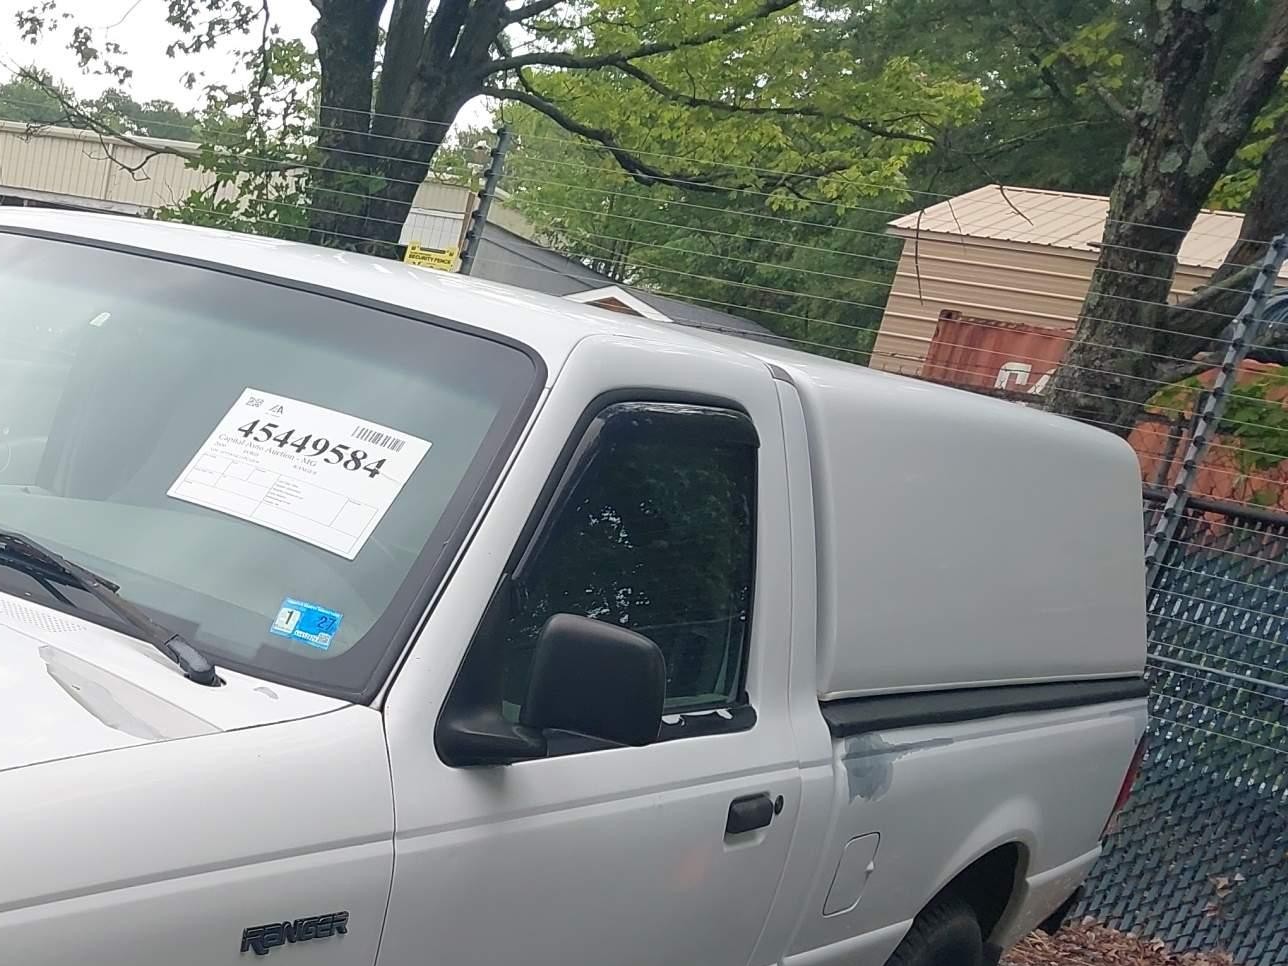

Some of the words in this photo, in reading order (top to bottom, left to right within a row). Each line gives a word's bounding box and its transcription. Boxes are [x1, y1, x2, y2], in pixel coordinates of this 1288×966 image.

[219, 433, 246, 447] Capital
[264, 446, 295, 462] Auction
[237, 419, 387, 479] 45449584
[240, 911, 349, 955] RANGER
